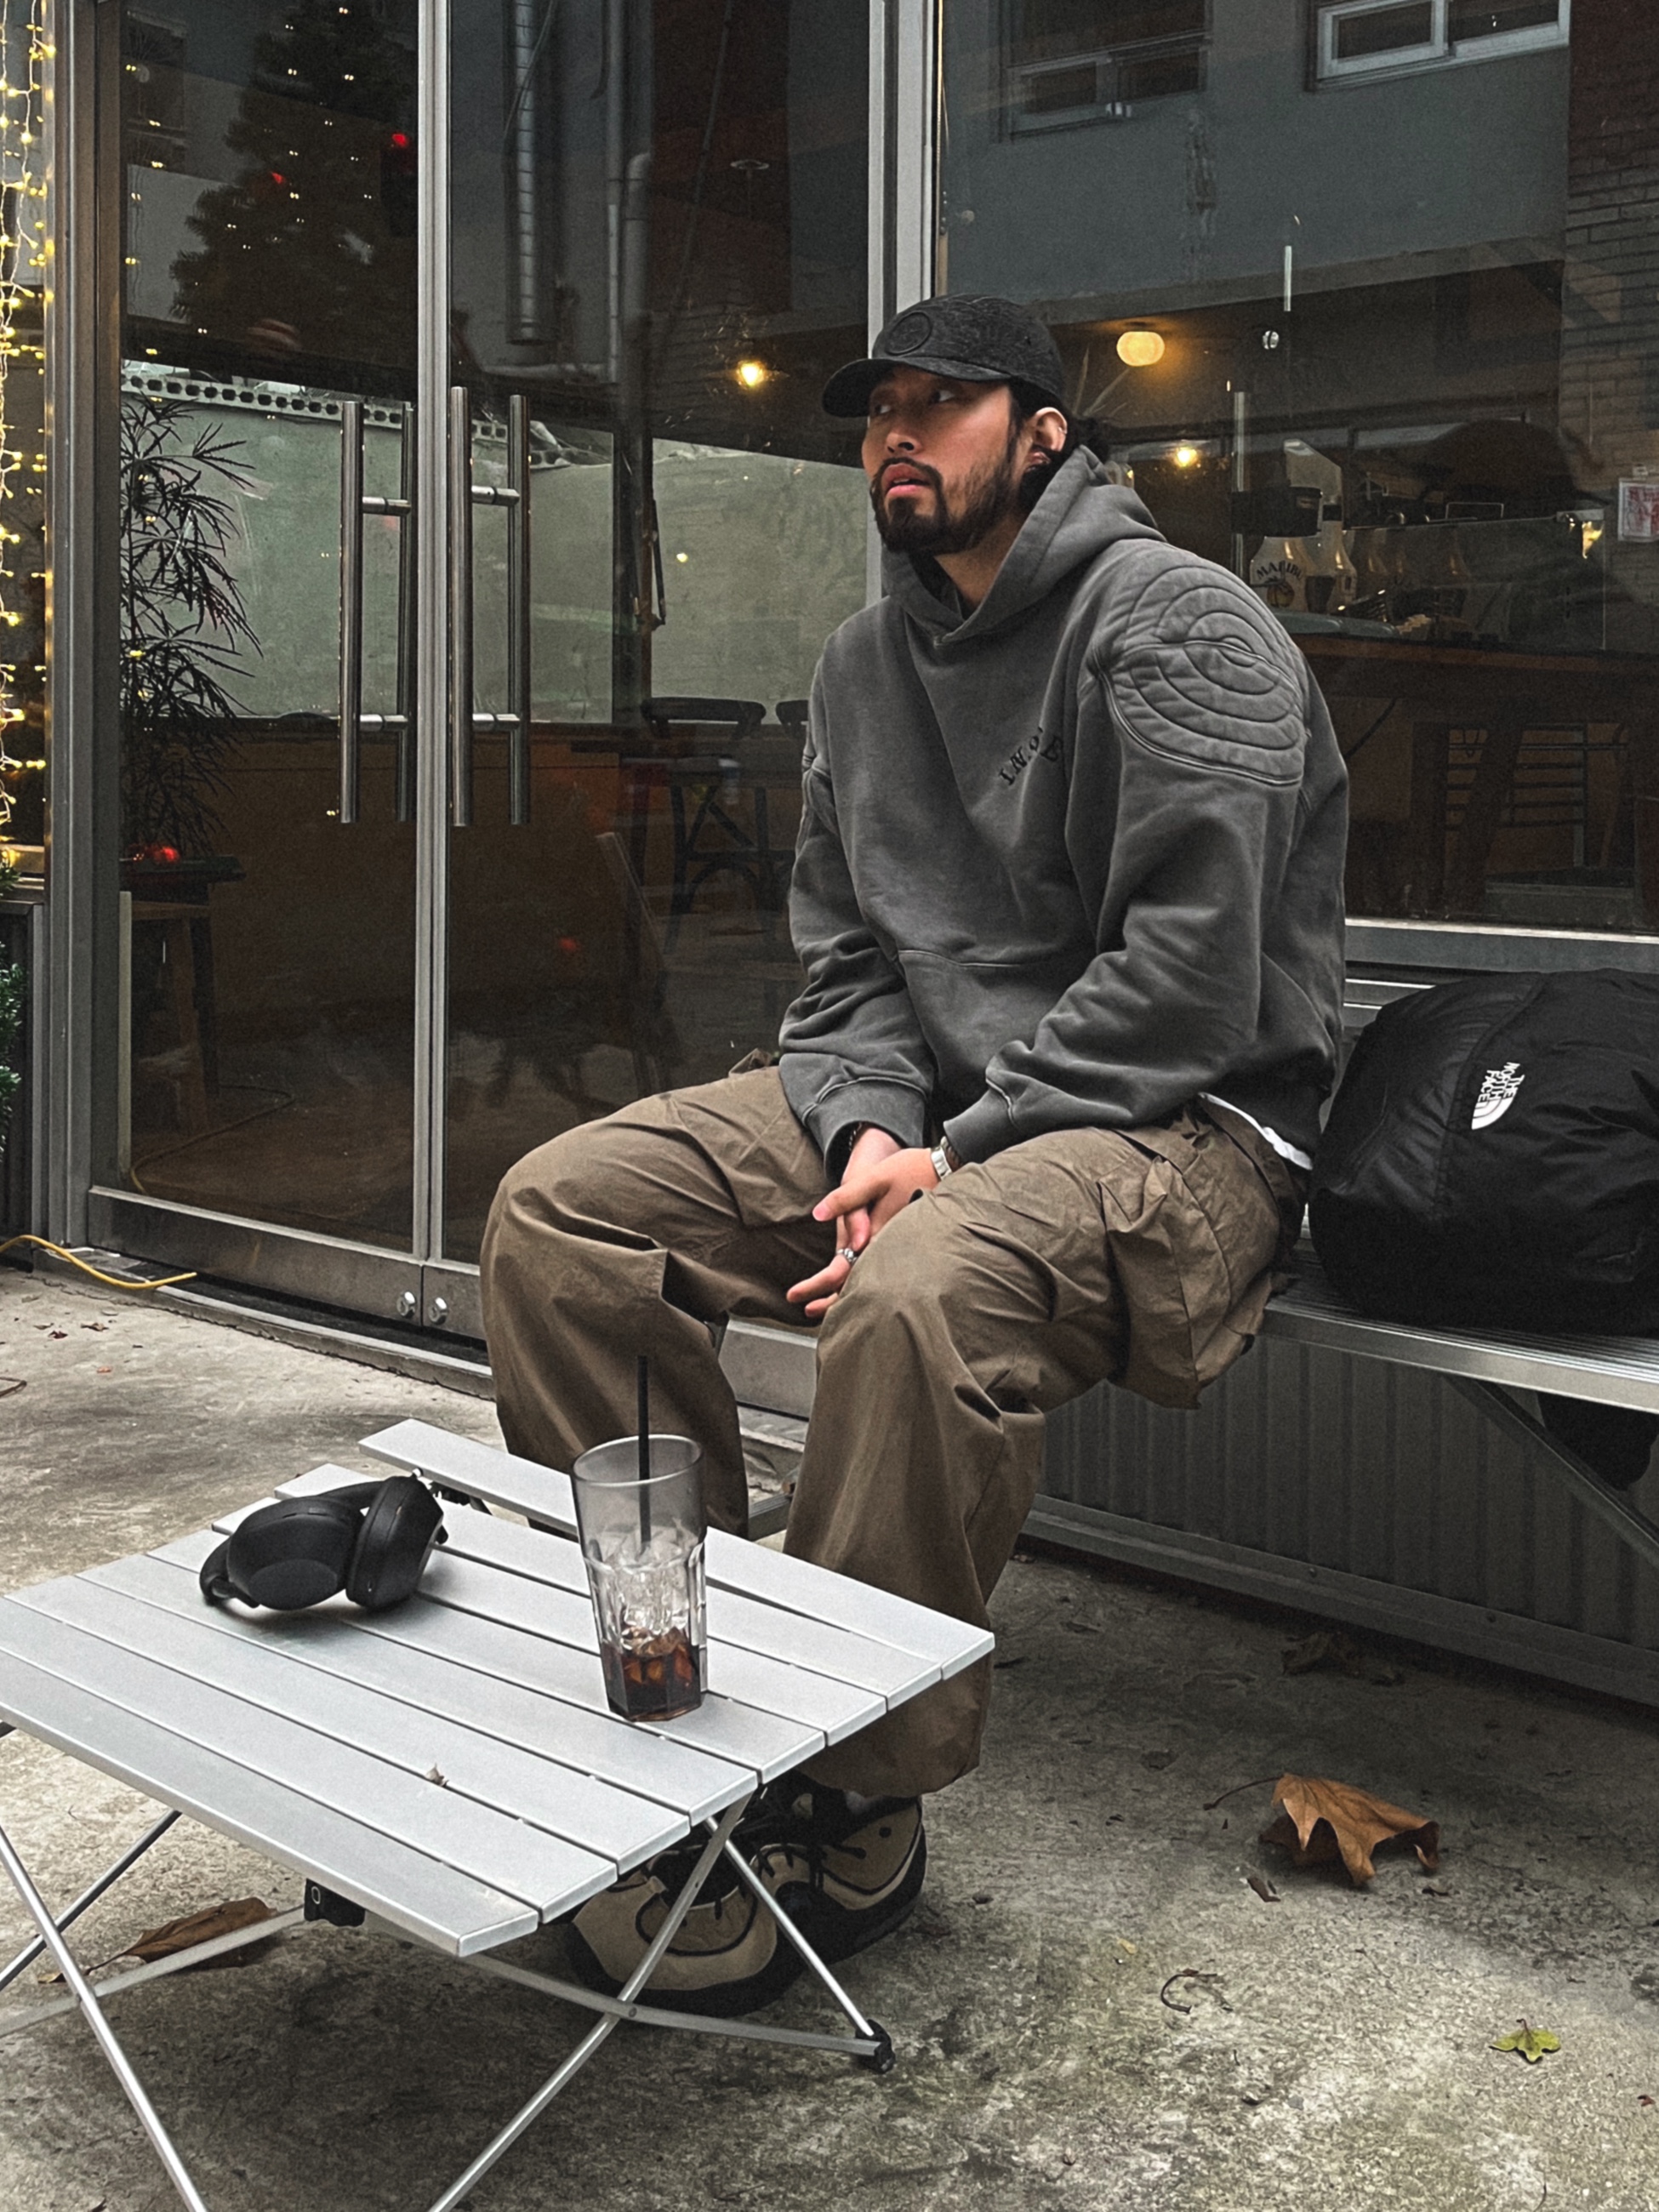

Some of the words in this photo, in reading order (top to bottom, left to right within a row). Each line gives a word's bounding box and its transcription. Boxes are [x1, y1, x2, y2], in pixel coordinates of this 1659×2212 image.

[1478, 1069, 1501, 1103] FACE
[1491, 1062, 1521, 1099] NORTH
[1502, 1075, 1525, 1098] THE
